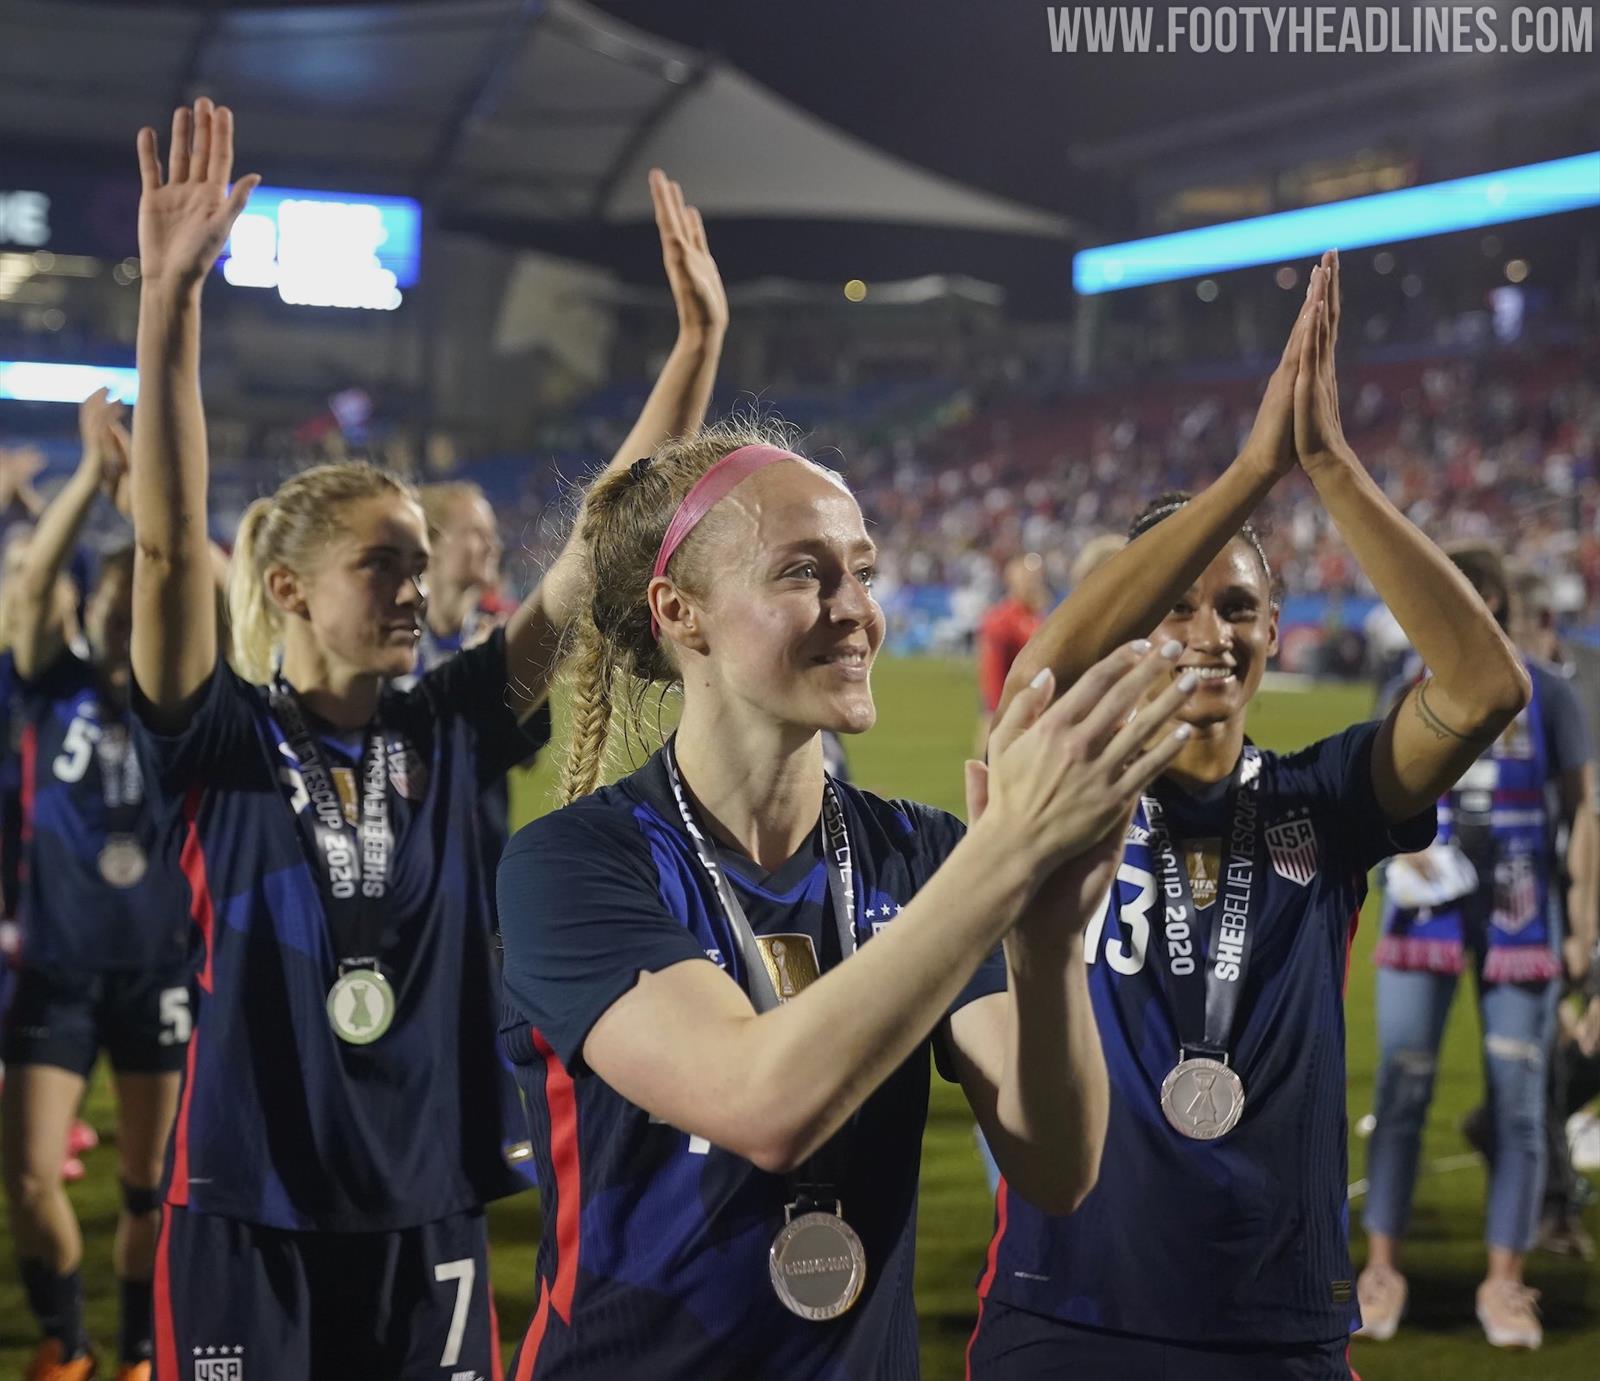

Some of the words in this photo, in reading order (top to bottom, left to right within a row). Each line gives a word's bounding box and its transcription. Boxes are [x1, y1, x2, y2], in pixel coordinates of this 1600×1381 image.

[52, 716, 101, 783] 5
[325, 834, 355, 899] 2020
[1267, 822, 1312, 850] USA
[1165, 905, 1195, 976] 2020
[158, 986, 192, 1046] 5
[434, 1258, 475, 1367] 7
